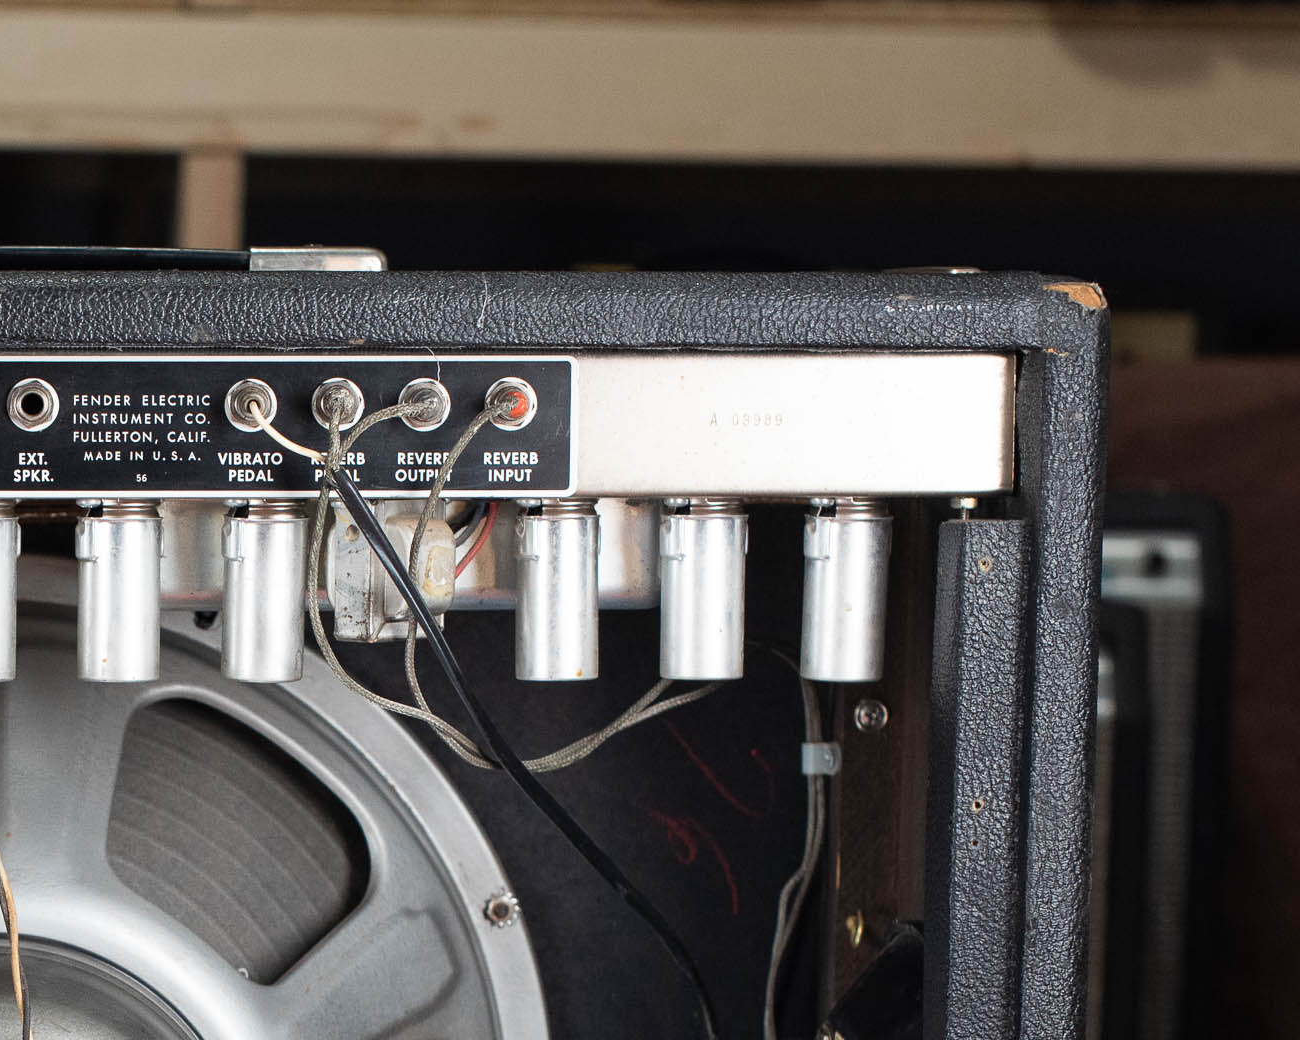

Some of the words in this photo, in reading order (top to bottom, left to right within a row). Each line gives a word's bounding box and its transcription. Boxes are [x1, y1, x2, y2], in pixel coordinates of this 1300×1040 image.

[73, 395, 131, 406] FENDER
[142, 395, 211, 406] ELECTRIC
[73, 413, 173, 425] INSTRUMENT
[185, 413, 211, 425] CO.
[709, 413, 719, 427] A
[73, 431, 159, 444] FULLERTON,
[167, 431, 211, 443] CALIF.
[18, 452, 48, 465] EXT.
[84, 451, 121, 461] MADE
[130, 451, 144, 461] IN
[218, 452, 284, 465] VIBRATO
[483, 452, 539, 465] REVERB
[13, 469, 54, 482] SPKR.
[136, 474, 148, 482] 56
[228, 469, 274, 482] PEDAL
[488, 469, 533, 482] INPUT
